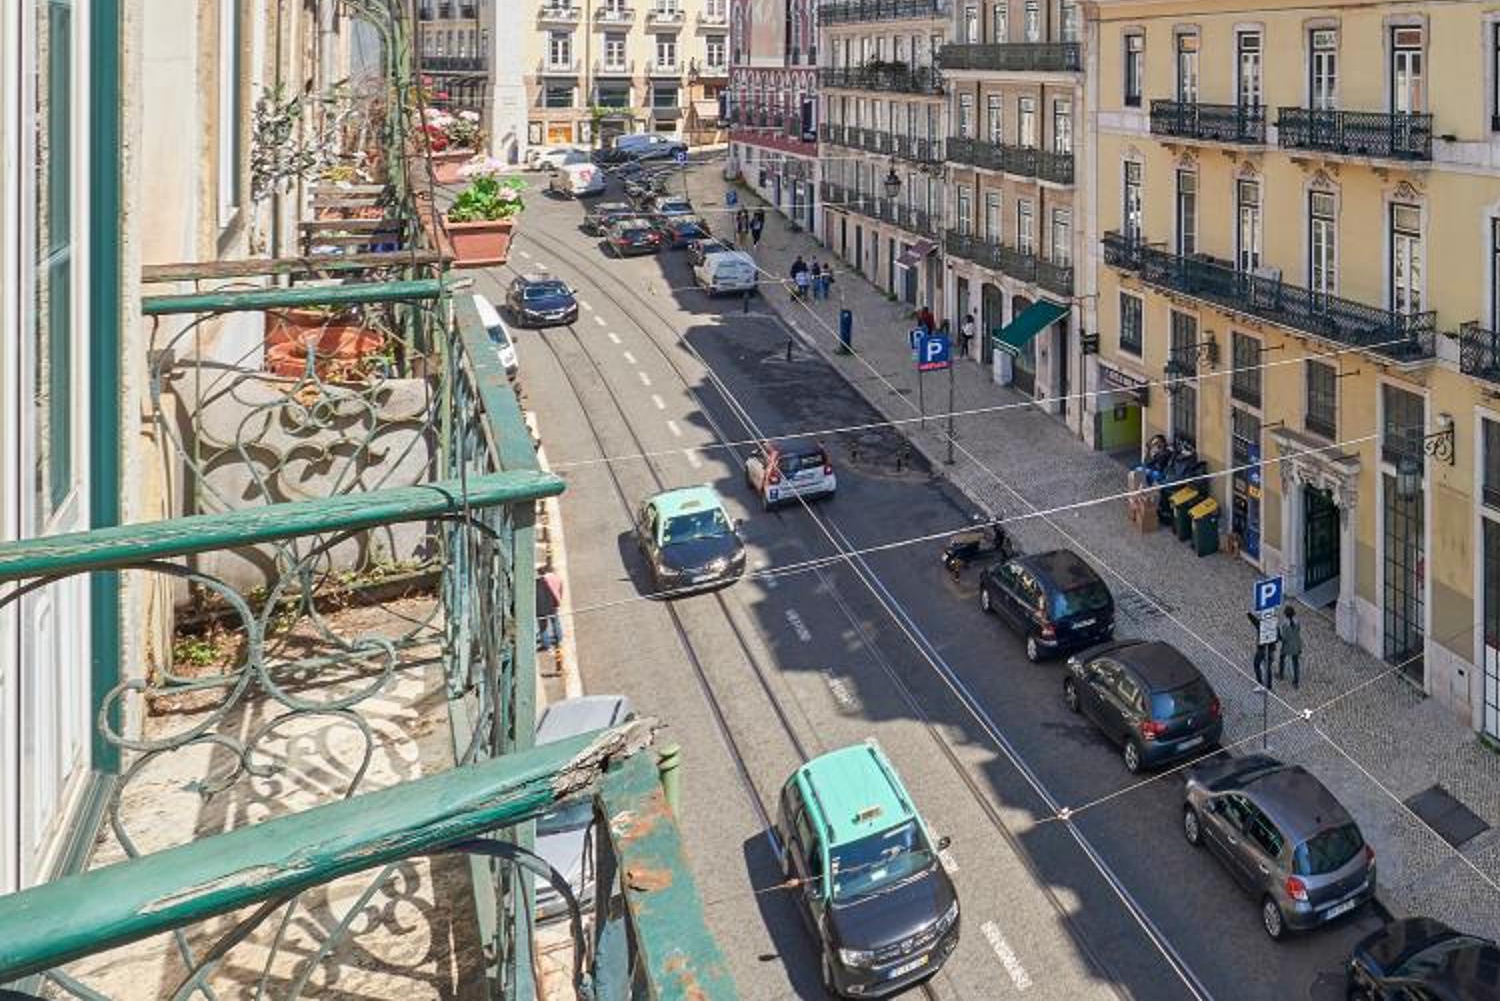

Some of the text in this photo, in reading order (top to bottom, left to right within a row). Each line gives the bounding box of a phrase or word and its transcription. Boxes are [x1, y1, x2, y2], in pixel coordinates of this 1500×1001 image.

[913, 330, 925, 349] P
[927, 342, 943, 362] P
[1260, 582, 1277, 607] P
